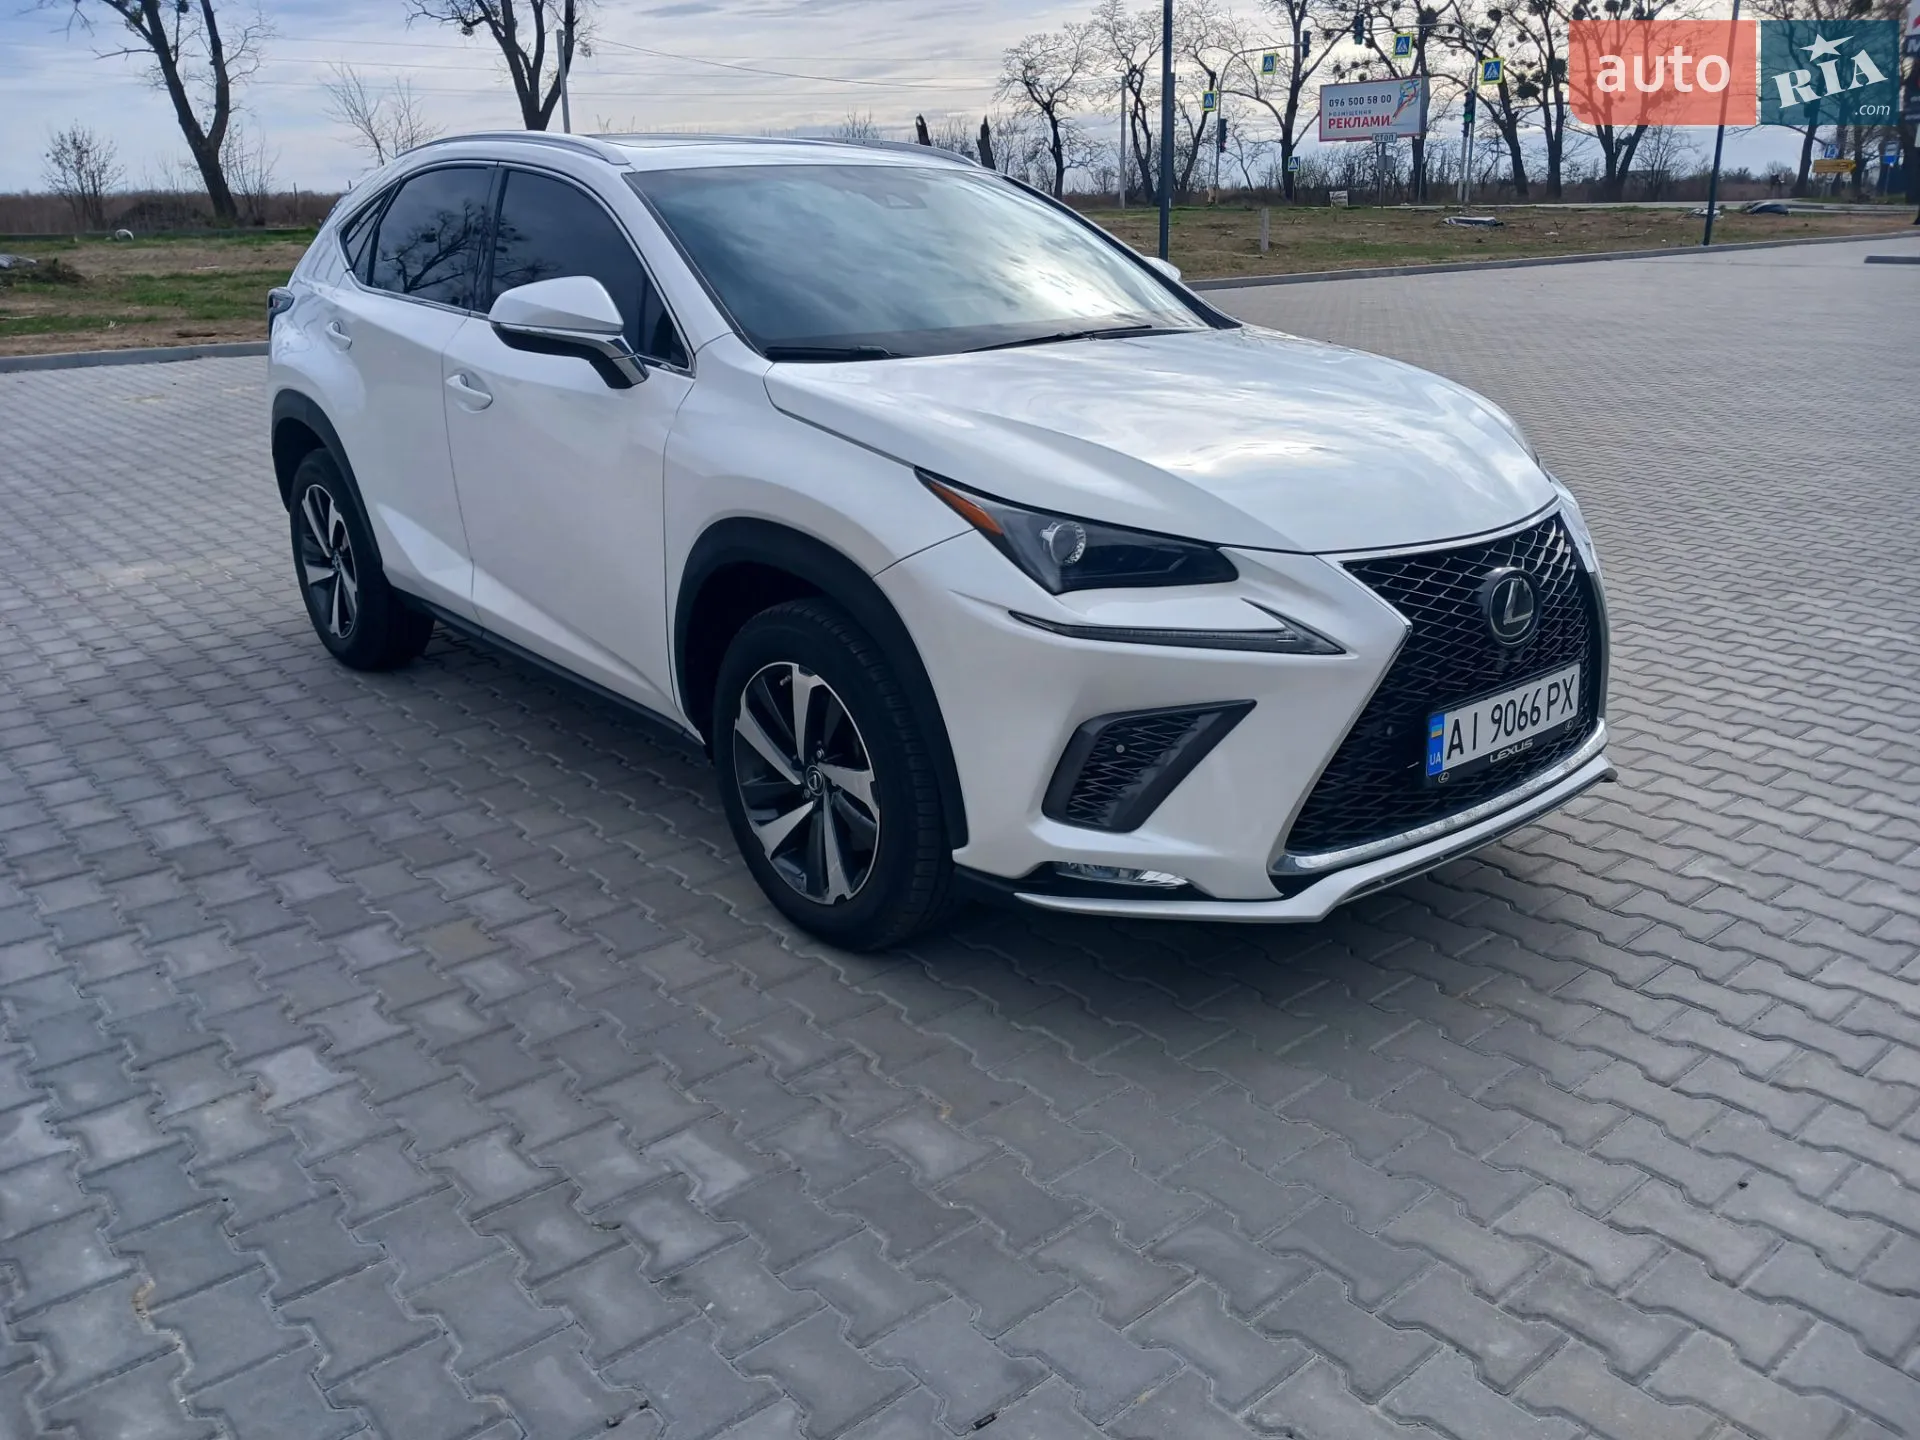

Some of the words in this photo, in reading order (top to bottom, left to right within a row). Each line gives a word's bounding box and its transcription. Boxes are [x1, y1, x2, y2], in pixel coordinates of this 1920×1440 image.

[1329, 99, 1344, 107] 096
[1348, 97, 1364, 106] 500
[1367, 95, 1378, 104] 58
[1380, 95, 1391, 103] 00
[1328, 115, 1391, 129] РЕКЛАМИ
[1446, 711, 1478, 761] AI
[1490, 687, 1542, 744] 9066
[1545, 673, 1576, 722] PX
[1489, 738, 1534, 764] LEXUS
[1429, 752, 1442, 766] UA
